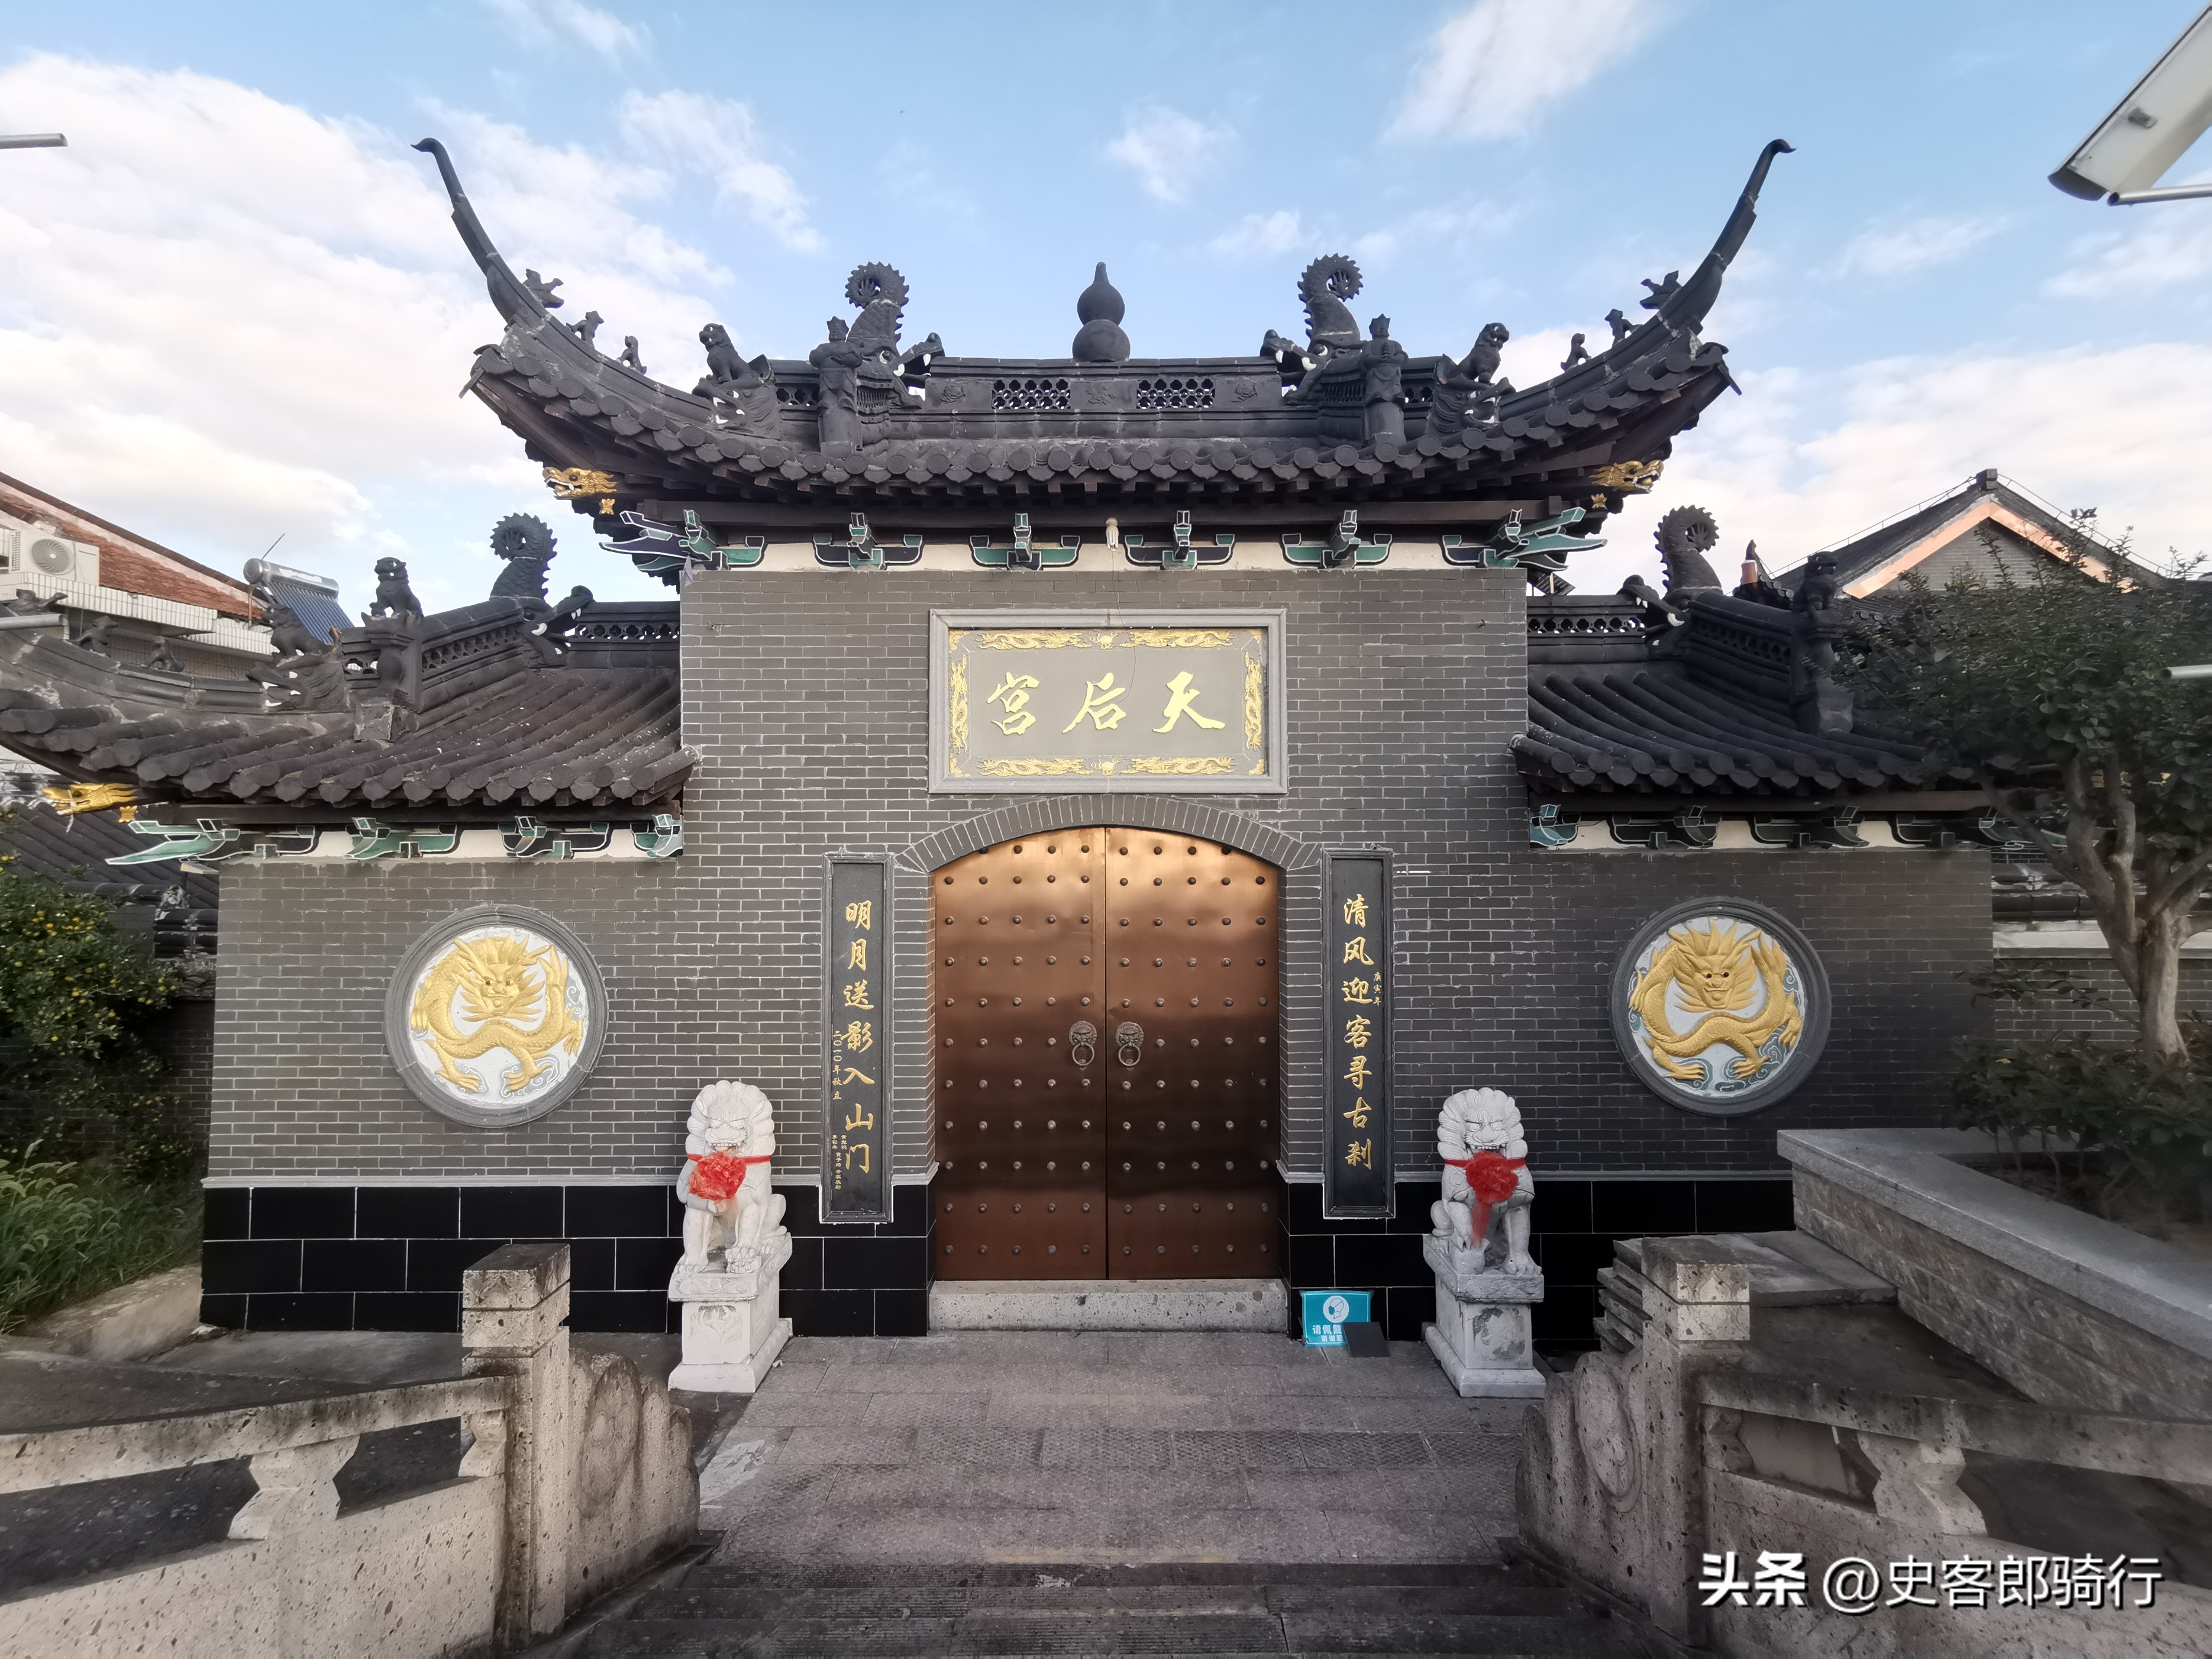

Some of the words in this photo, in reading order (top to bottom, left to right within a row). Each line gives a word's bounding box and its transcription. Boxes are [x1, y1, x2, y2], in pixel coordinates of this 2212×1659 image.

[987, 671, 1226, 735] 天后宫
[841, 900, 875, 1174] 明月送影入山门
[1341, 893, 1374, 1170] 清风迎客寻古刹
[1373, 971, 1382, 1007] 庚寅年
